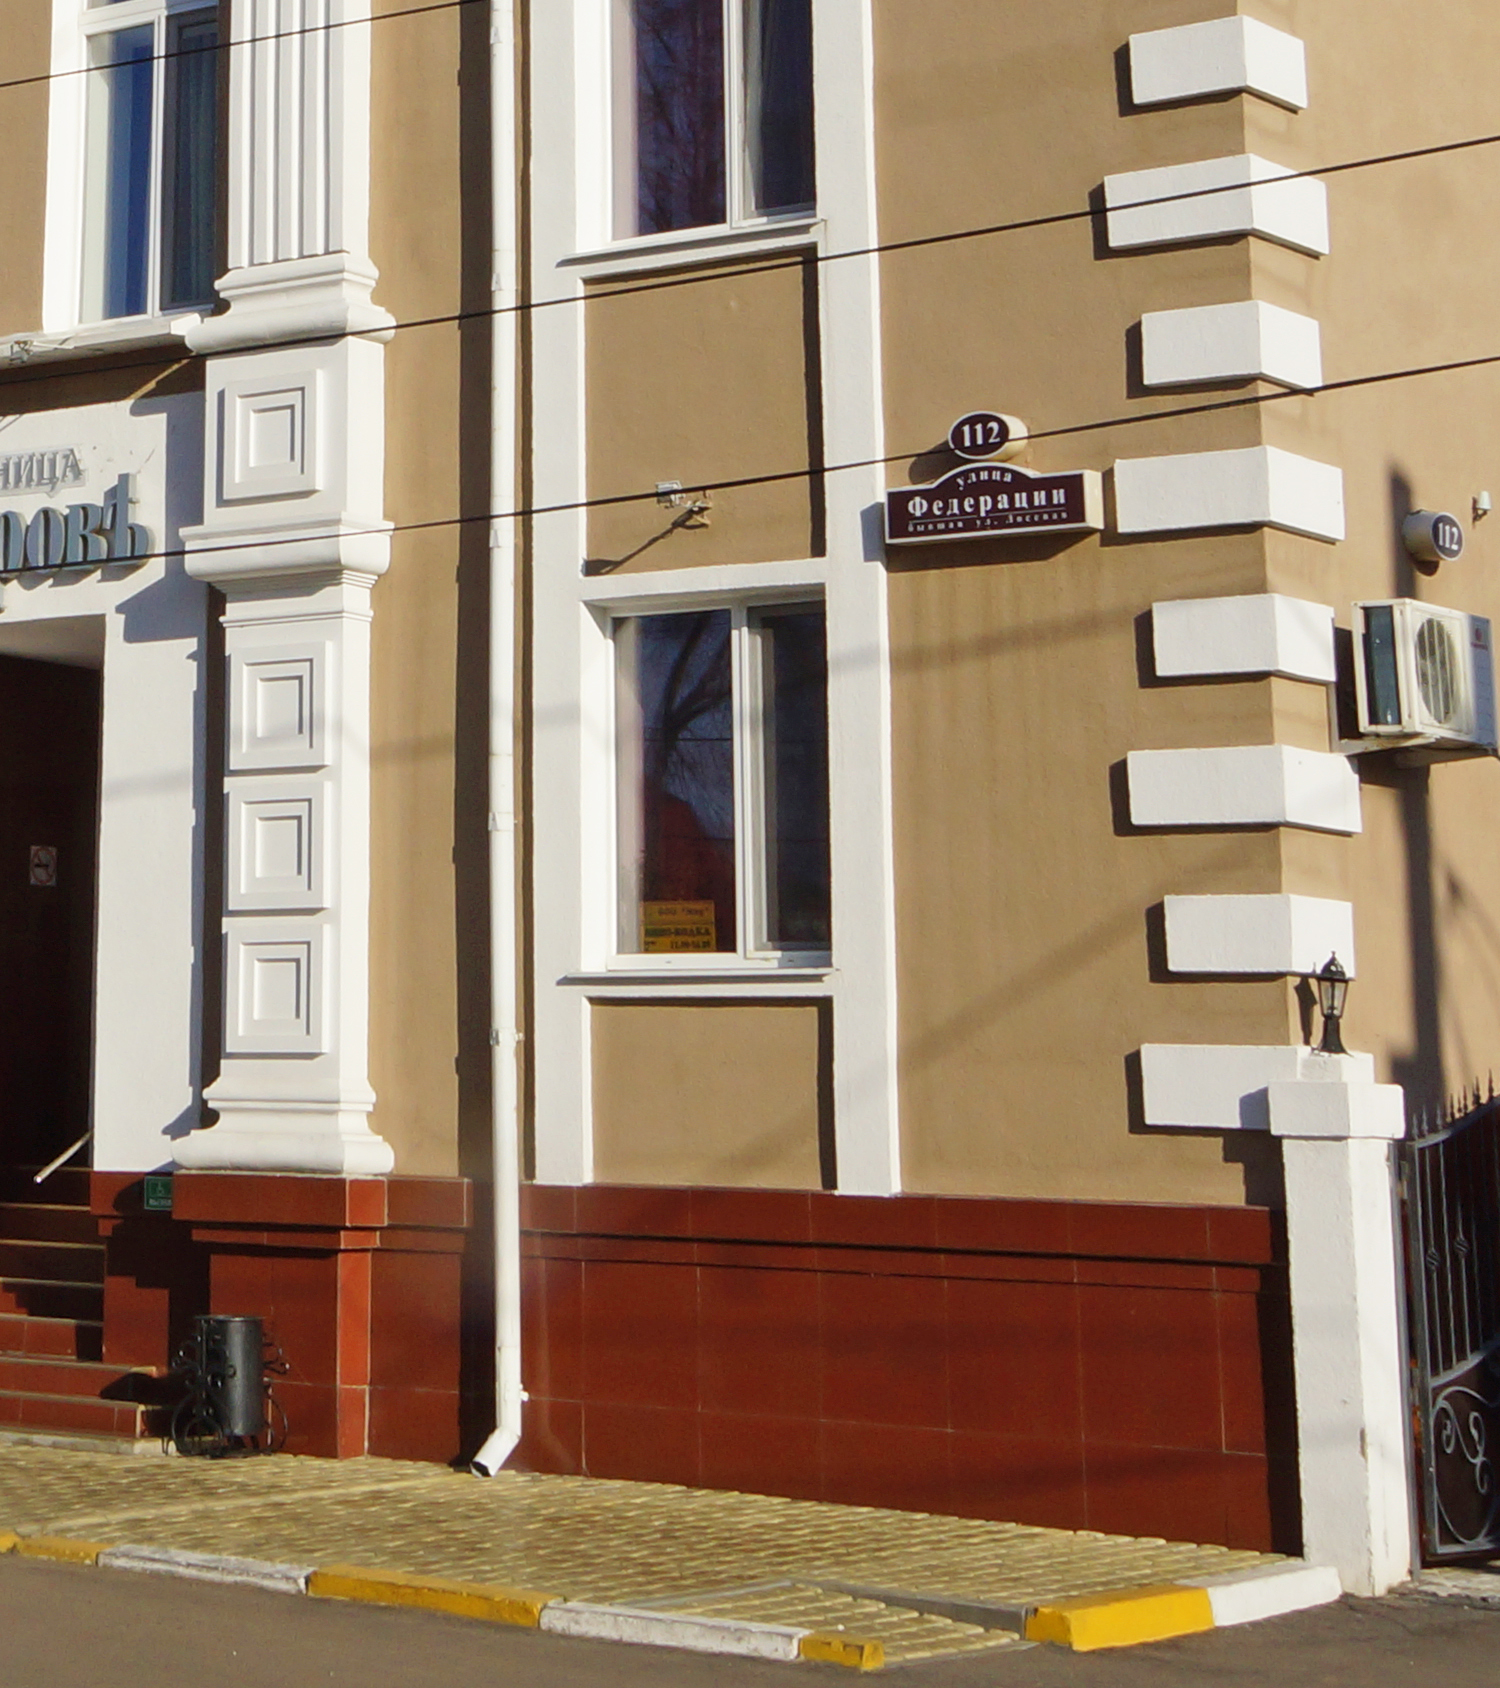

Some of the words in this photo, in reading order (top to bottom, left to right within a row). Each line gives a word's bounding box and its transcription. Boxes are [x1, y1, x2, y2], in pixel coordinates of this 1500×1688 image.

[961, 420, 1001, 448] 112
[956, 469, 1013, 491] улица
[907, 488, 1066, 518] Федерации
[1438, 522, 1459, 551] 112
